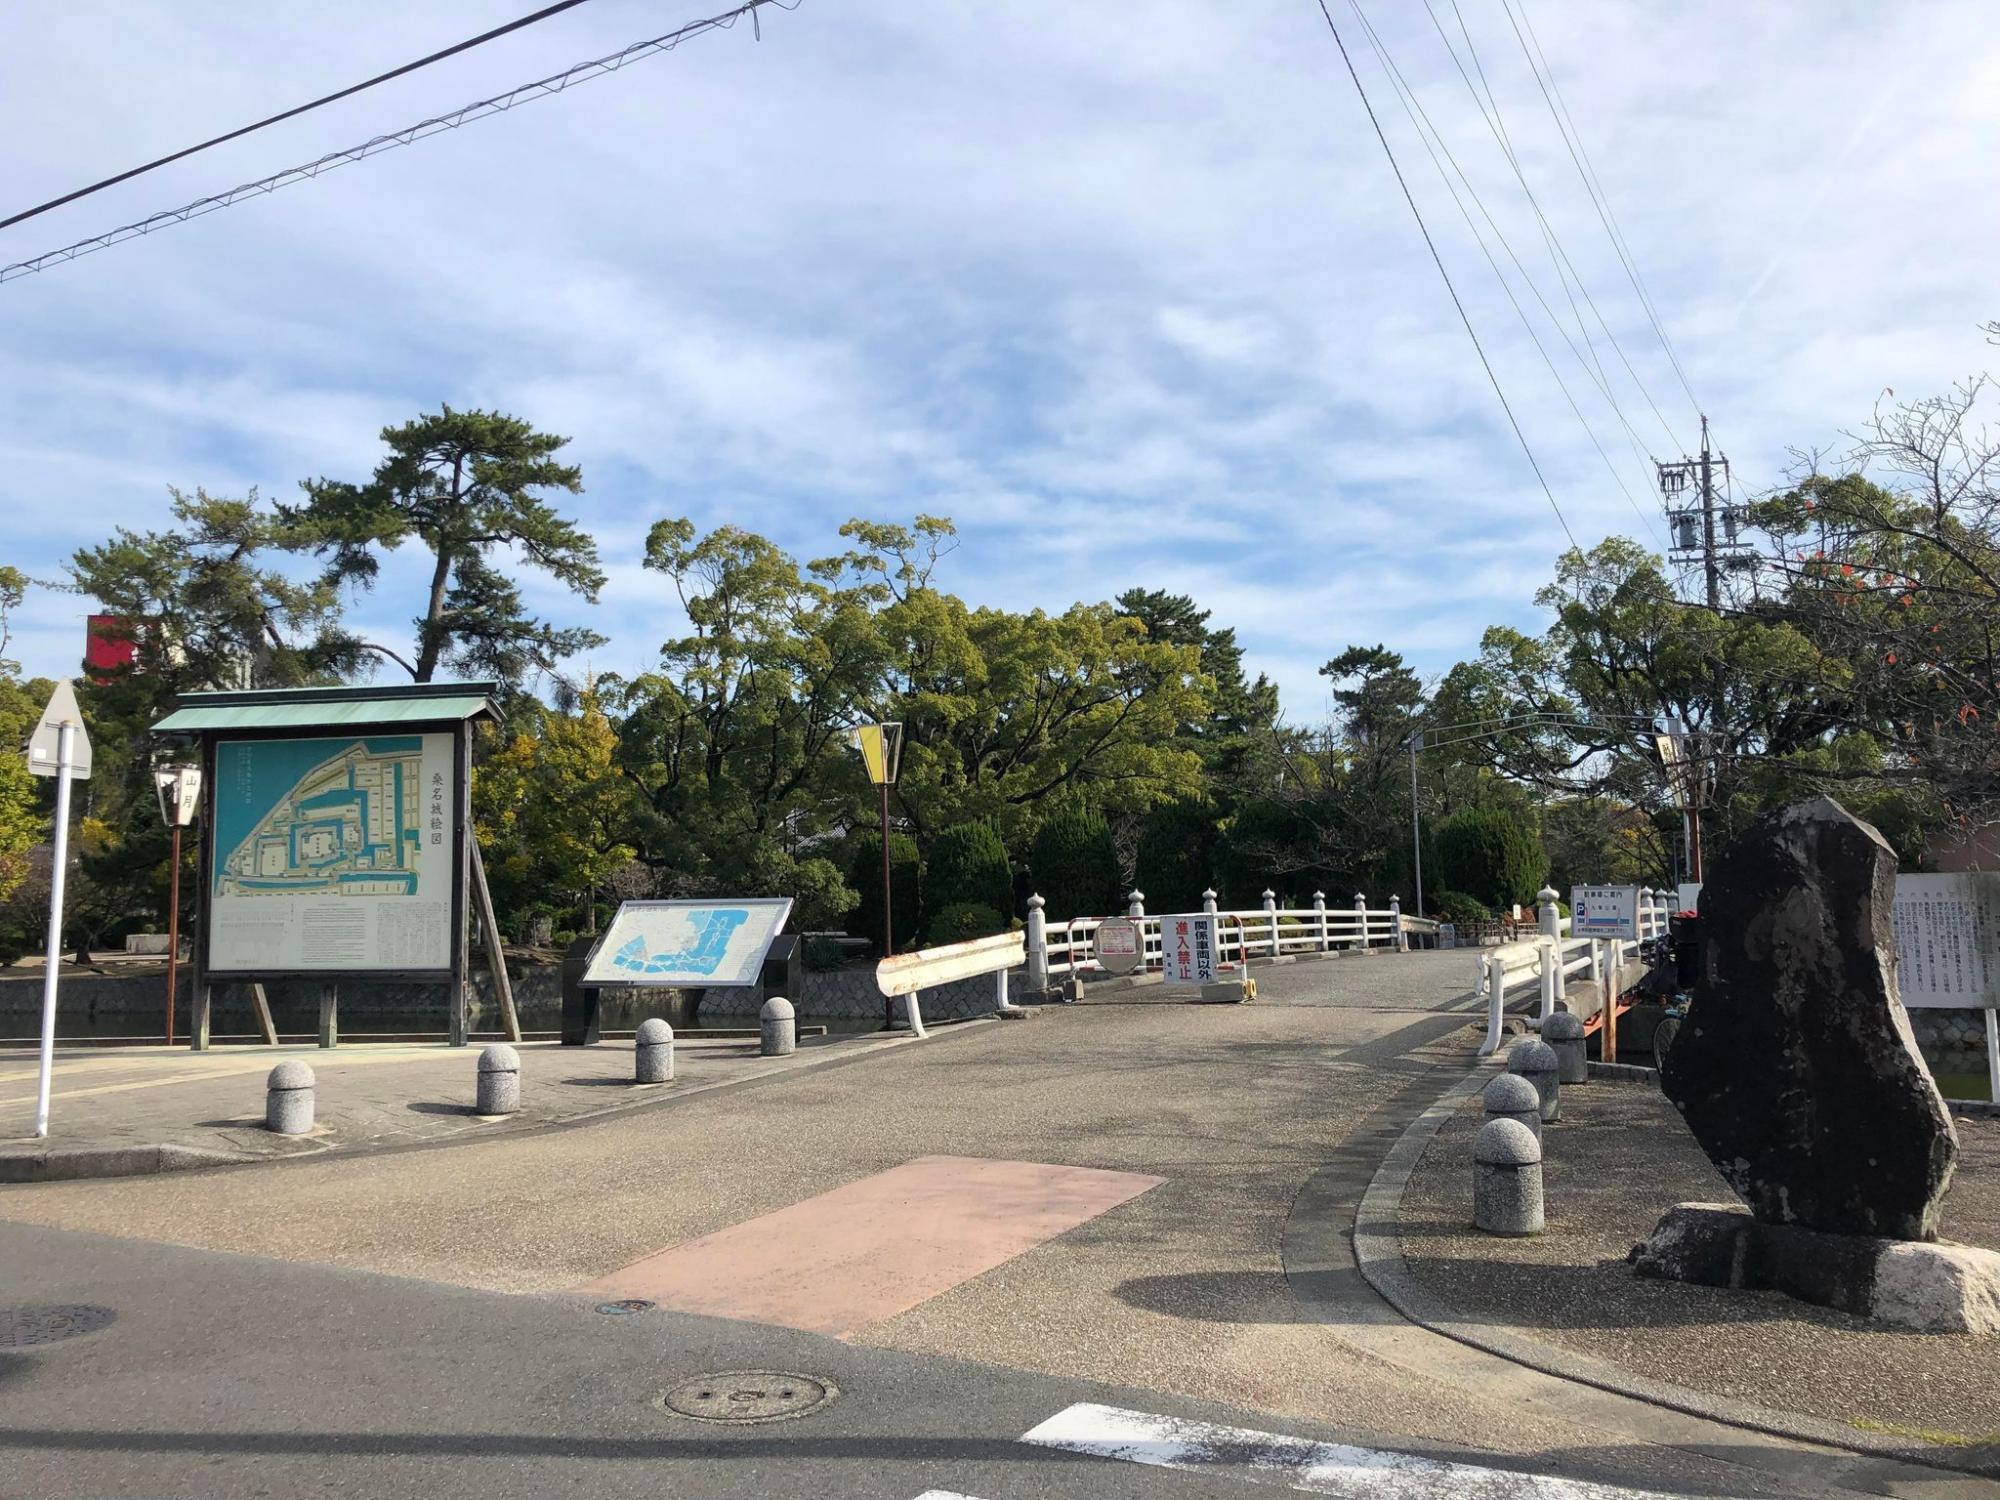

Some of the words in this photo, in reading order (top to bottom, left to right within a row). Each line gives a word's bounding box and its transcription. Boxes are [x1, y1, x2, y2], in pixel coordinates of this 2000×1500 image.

[430, 772, 444, 845] 桑名城絵図
[1175, 920, 1192, 979] 進入禁止
[1194, 920, 1211, 980] 関係車両以外
